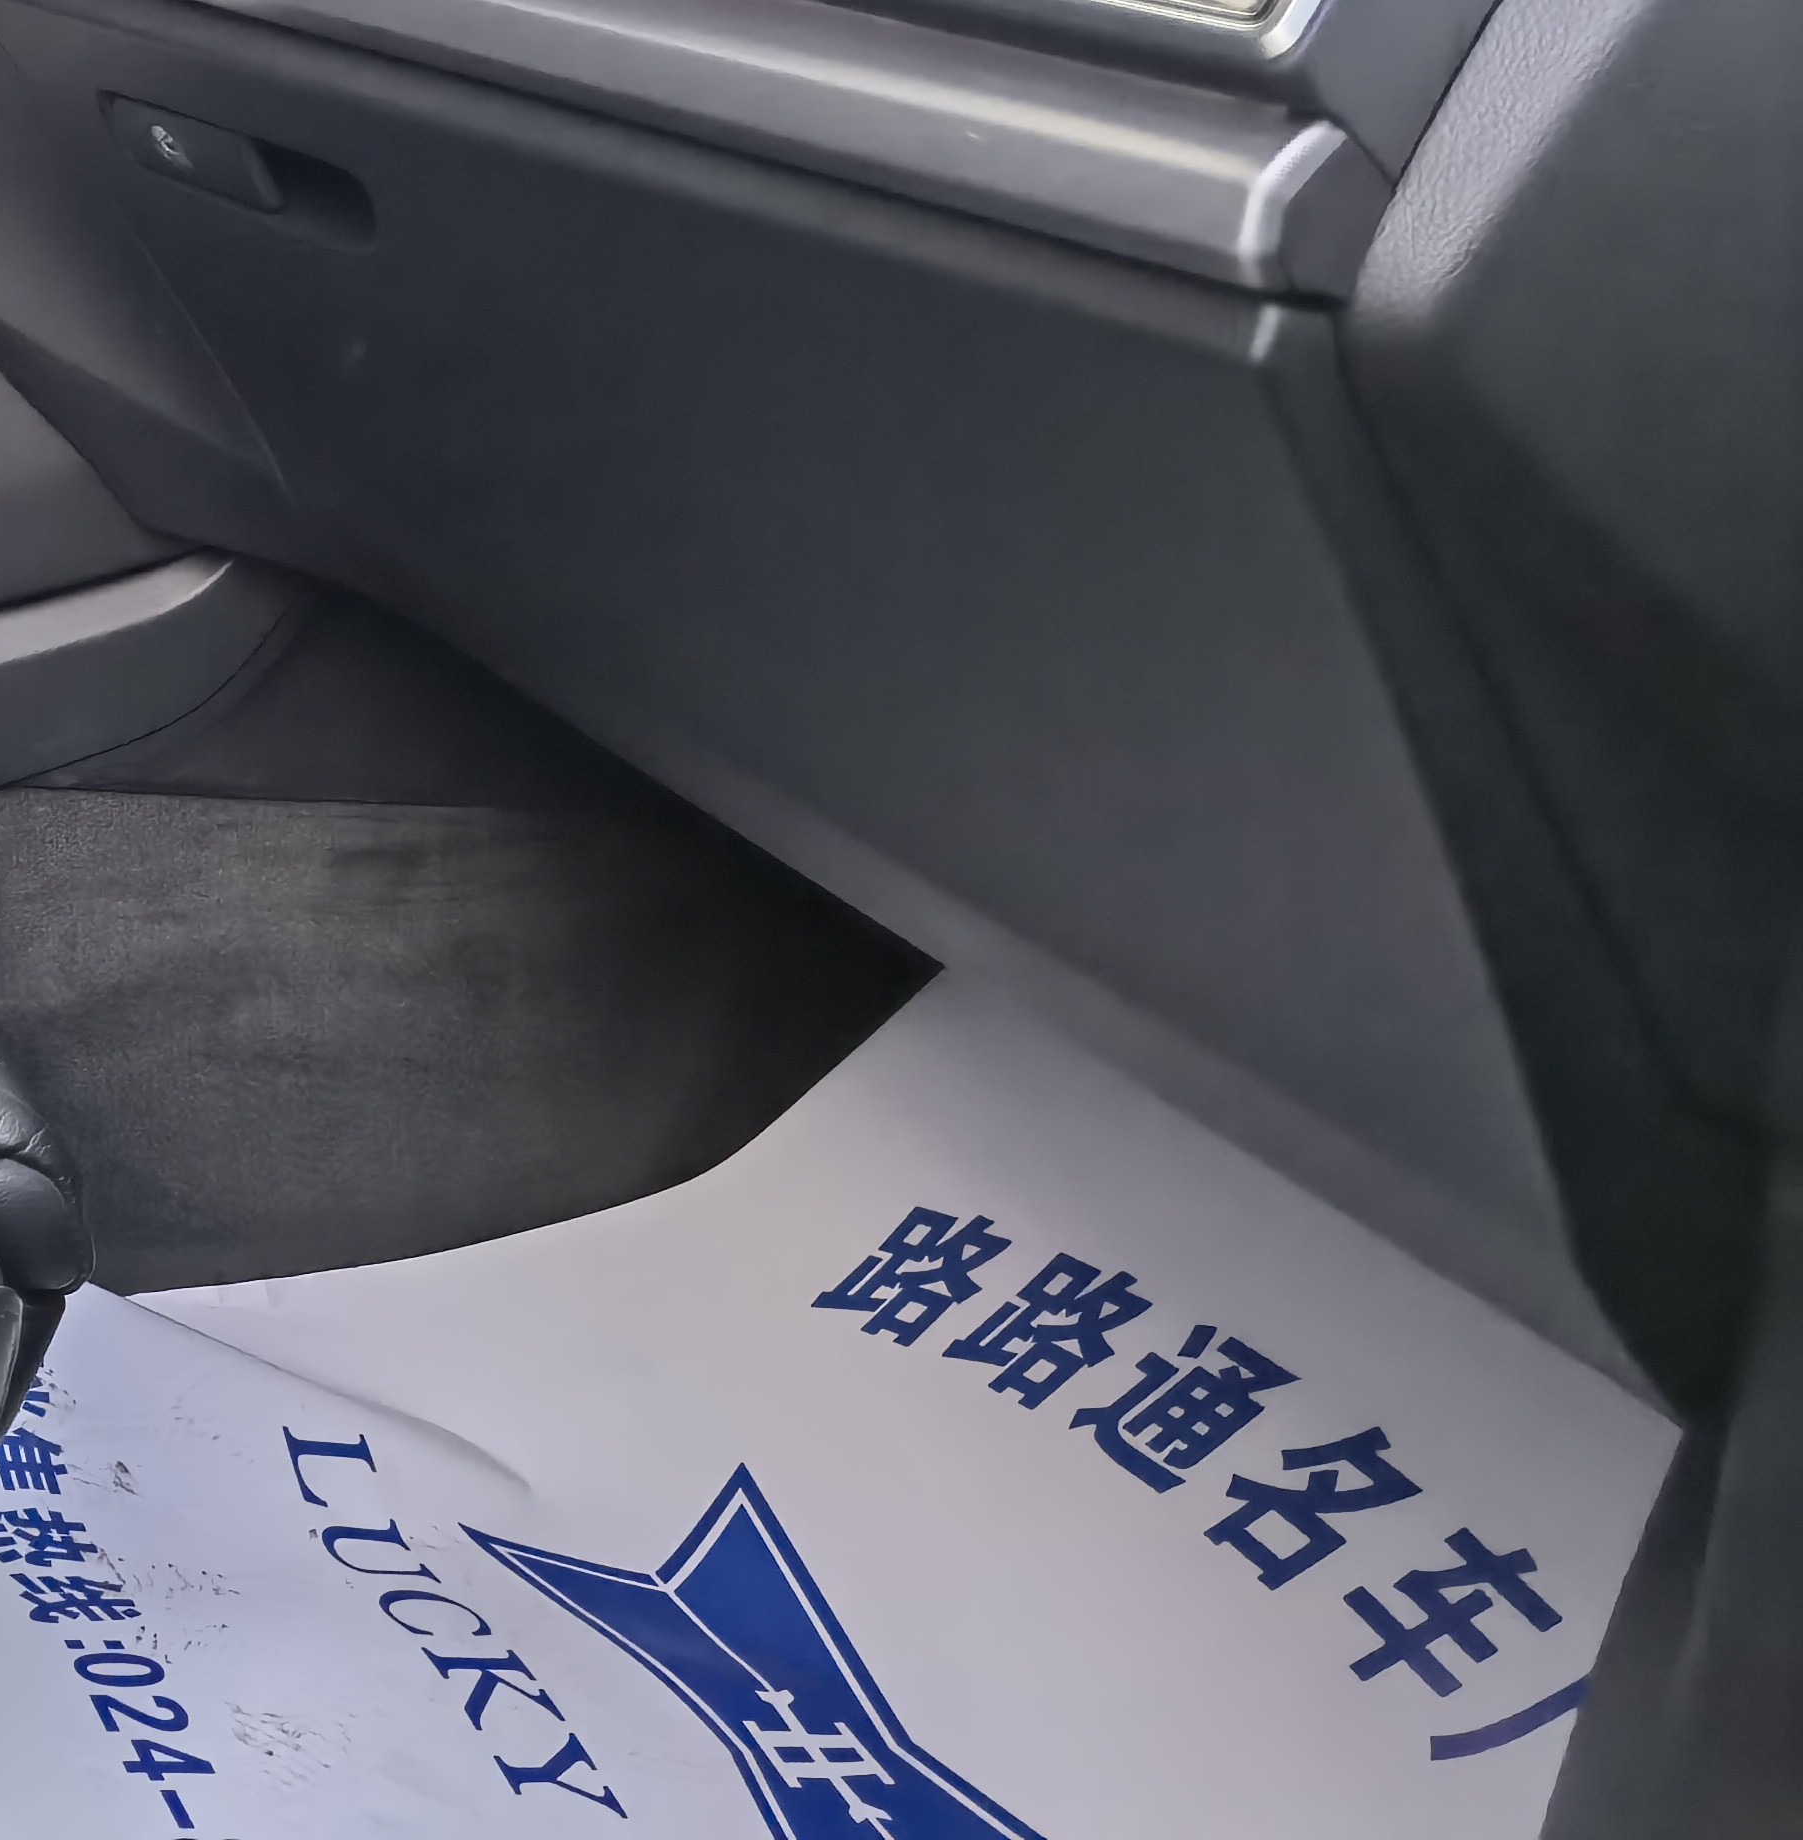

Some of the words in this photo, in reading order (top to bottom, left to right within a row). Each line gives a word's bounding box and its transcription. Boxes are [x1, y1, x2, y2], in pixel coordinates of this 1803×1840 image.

[282, 1425, 628, 1819] LUCKY
[812, 1205, 1590, 1761] 路路通名车
